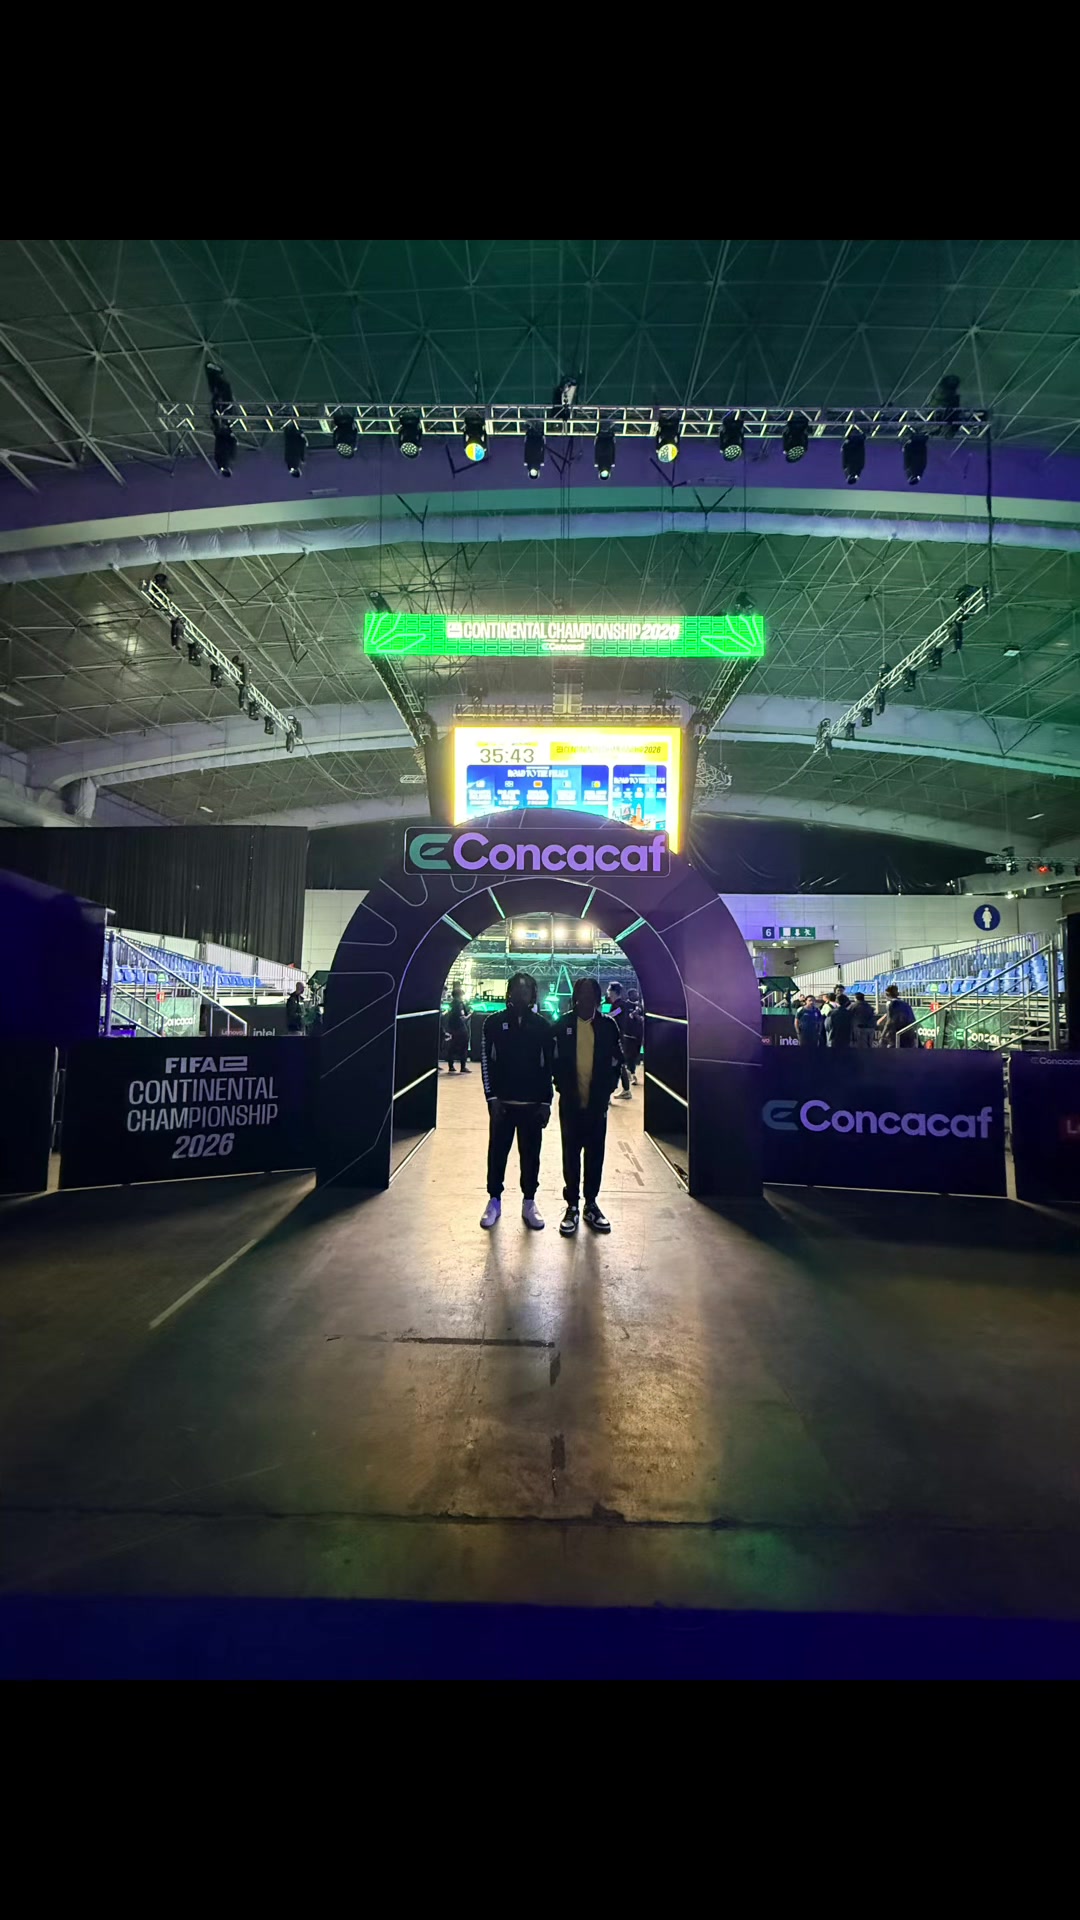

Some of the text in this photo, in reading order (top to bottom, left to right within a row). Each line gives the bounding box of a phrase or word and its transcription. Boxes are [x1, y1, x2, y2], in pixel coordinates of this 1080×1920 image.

[463, 622, 546, 639] CONTINENTAL
[548, 622, 640, 639] CHAMPIONSHIP
[480, 748, 534, 763] 35:43
[765, 928, 772, 937] 6
[128, 1076, 279, 1105] CONTINENTAL
[127, 1103, 278, 1132] CHAMPIONSHIP
[172, 1132, 235, 1159] 2026
